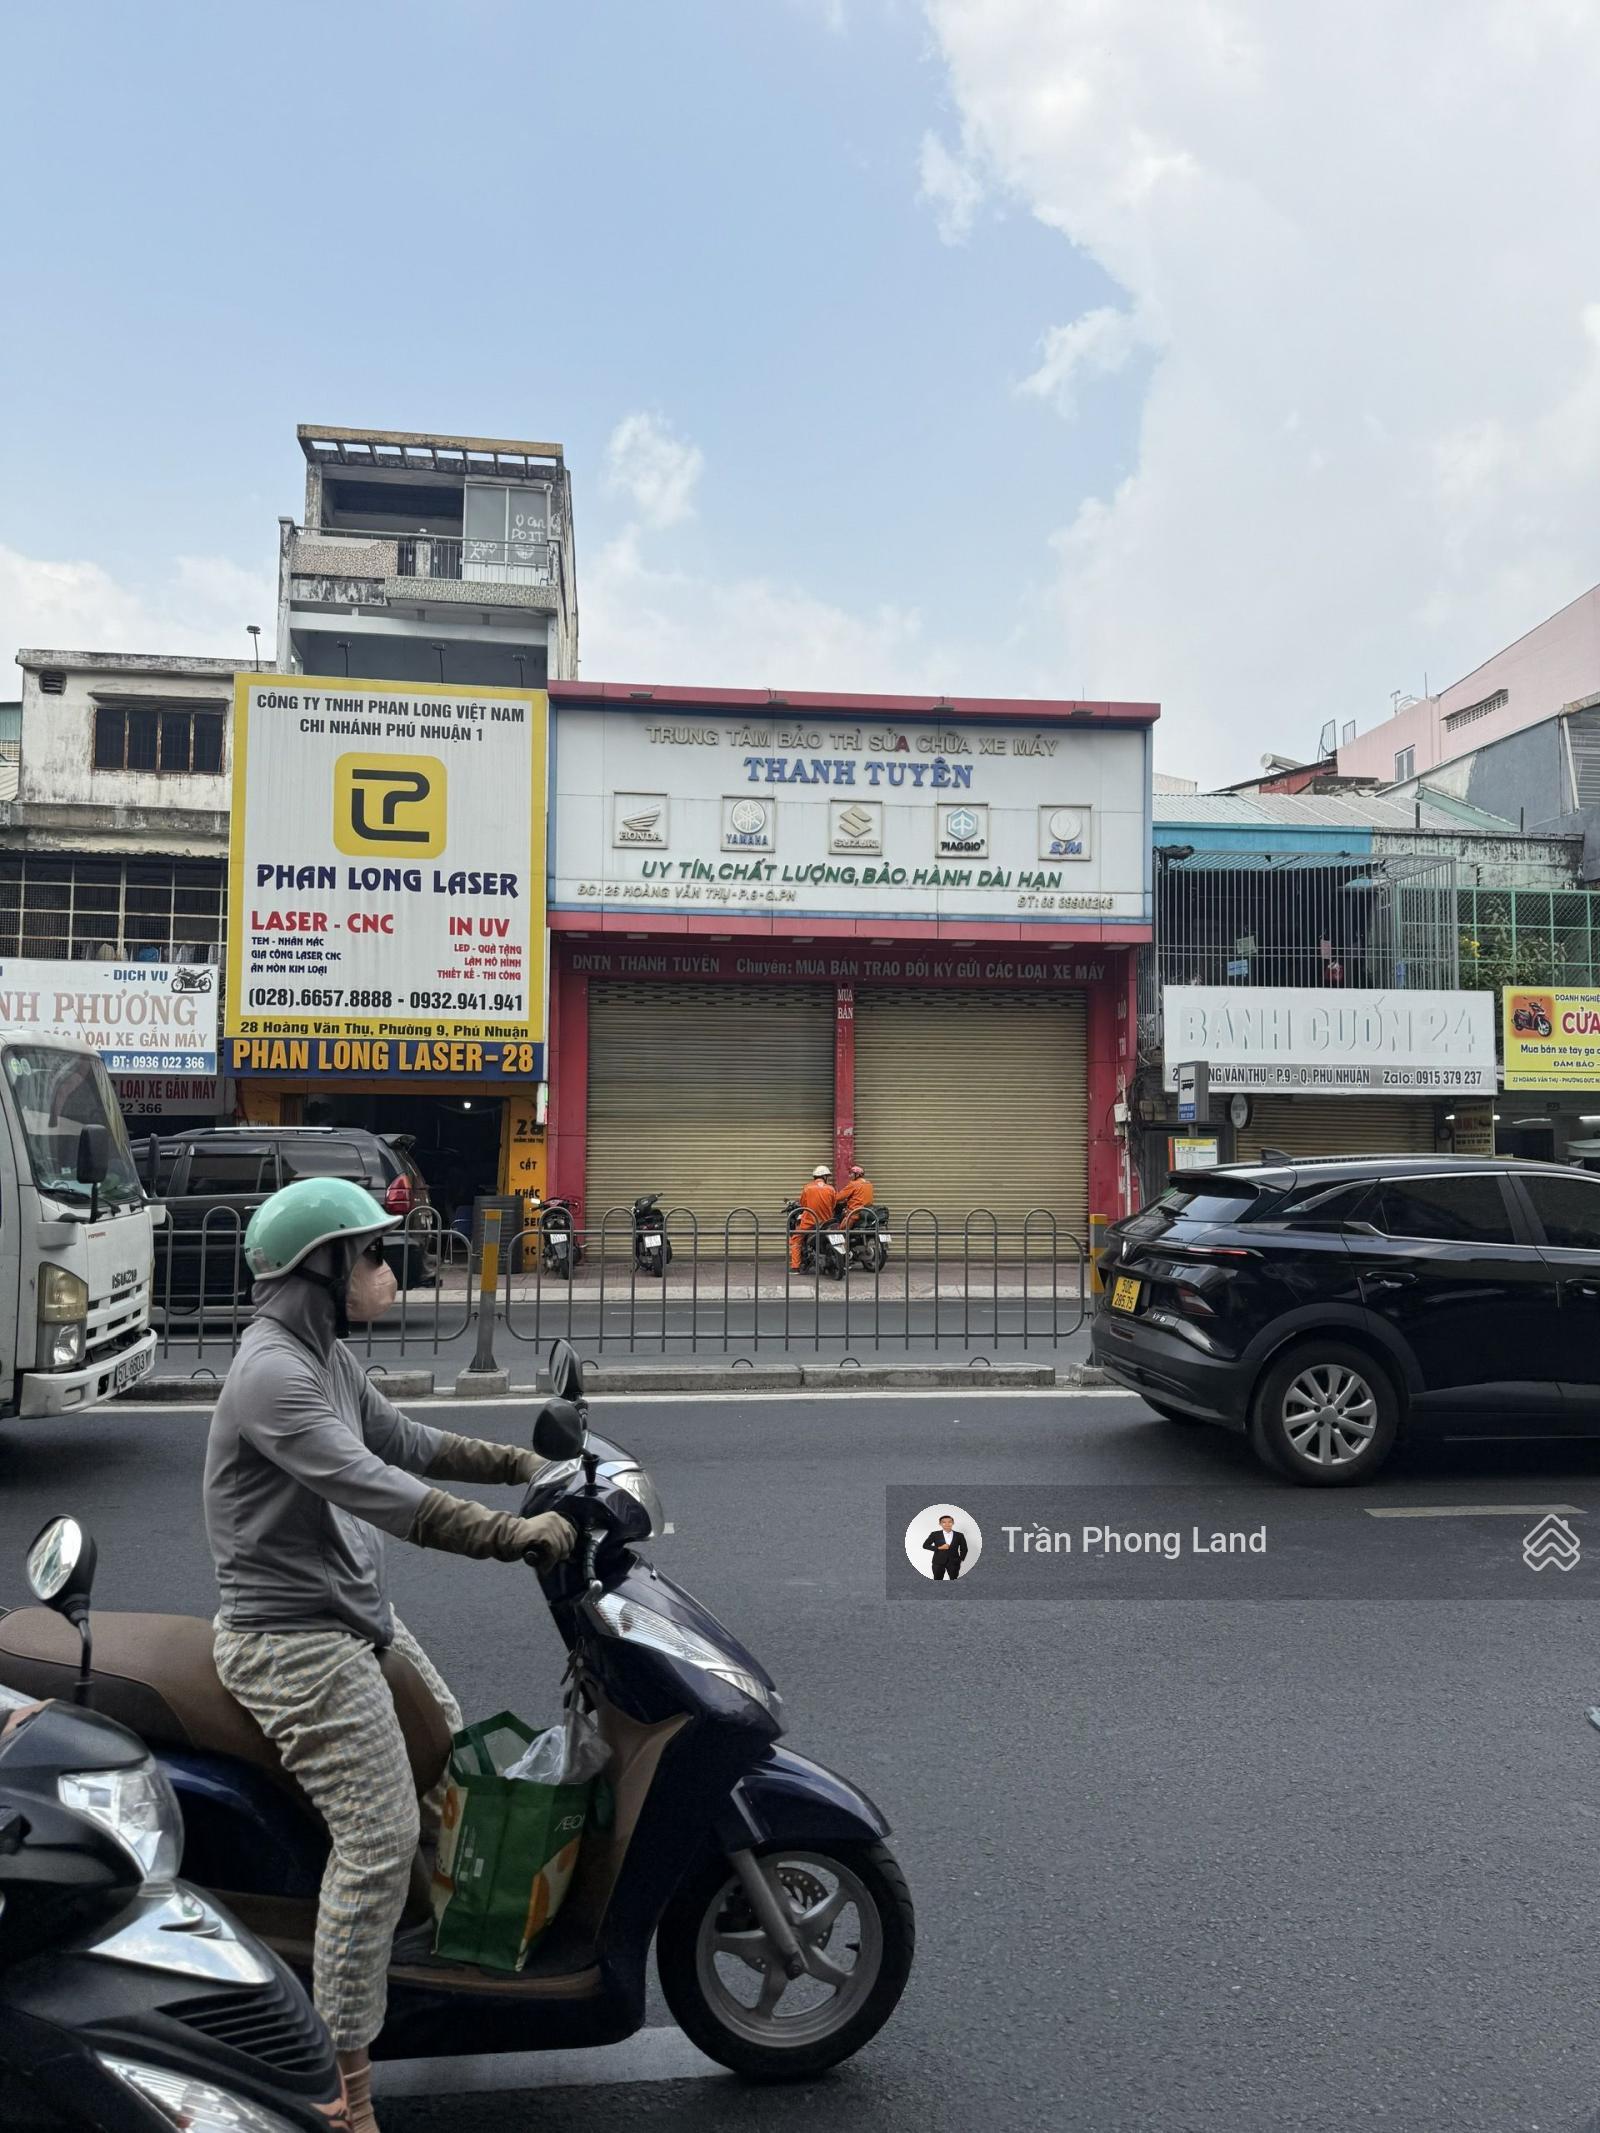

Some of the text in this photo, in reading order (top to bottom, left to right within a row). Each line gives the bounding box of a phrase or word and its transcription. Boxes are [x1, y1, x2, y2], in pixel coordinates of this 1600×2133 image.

[257, 692, 524, 723] CÔNG TY TNHH PHAN LONG VIỆT NAM
[299, 718, 483, 743] CHI NHÁNH PHÚ NHUẬN 1
[646, 723, 1059, 757] TRUNG TÂM BẢO TRÌ SỬA CHỮA XE MÁY
[743, 756, 973, 788] THANH TUYÊN
[619, 831, 663, 842] HONDA
[726, 833, 769, 847] YAMAHA
[257, 864, 519, 899] PHAN LONG LASER
[641, 860, 673, 879] UY
[912, 864, 972, 887] HÀNH
[977, 866, 1011, 887] DÀI
[1017, 871, 1063, 891] HẠN
[251, 910, 393, 934] LASER CNC
[449, 916, 510, 937] IN UV
[251, 936, 269, 945] TEM
[454, 943, 522, 957] LED QUÀ TẶNG
[251, 948, 342, 961] GIA CÔNG LASER CNC
[464, 956, 522, 968] LÀM MÔ HÌNH
[113, 969, 168, 984] DỊCH VỤ
[266, 962, 286, 973] MÒN
[288, 964, 305, 974] KIM
[307, 965, 328, 976] LOẠI
[482, 971, 497, 980] THI
[498, 970, 521, 981] CÔNG
[572, 954, 611, 972] DNTN
[618, 955, 666, 972] THANH
[736, 957, 792, 977] Chuyên:
[795, 959, 826, 975] MUA
[830, 957, 858, 976] BÁN
[863, 960, 901, 976] TRAO
[934, 958, 954, 977] KÝ
[985, 959, 1015, 978] CÁC
[1016, 962, 1047, 983] LOẠI
[1052, 964, 1071, 979] XE
[1075, 960, 1105, 980] MÁY
[249, 988, 522, 1011] (028).6657.8888 0932.941.941
[837, 988, 853, 1001] MUA
[53, 988, 198, 1026] PHƯƠNG
[837, 1004, 853, 1020] BÁN
[240, 1021, 528, 1040] 28 Hoàng Văn Thụ, Phường 9, Phú Nhuận
[1180, 996, 1475, 1054] BÁNH CUỐN 24
[115, 1032, 134, 1047] XE
[139, 1027, 170, 1047] GẮN
[175, 1029, 208, 1047] MÁY
[233, 1039, 309, 1070] PHAN
[318, 1040, 389, 1070] LONG
[1520, 1044, 1539, 1054] Mua
[1541, 1044, 1556, 1054] bán
[1569, 1045, 1582, 1056] tay
[1584, 1048, 1594, 1056] ga
[112, 1055, 205, 1069] ĐT: 0936 022 366
[1225, 1066, 1482, 1087] VĂN THỤ P.9 Q. PHÚ NHUẬN Zalo: 0915 379 237
[120, 1079, 145, 1102] LOẠI
[148, 1080, 162, 1099] XE
[192, 1076, 217, 1099] MÁY
[137, 1103, 162, 1114] 366
[112, 1269, 138, 1289] ISUZU
